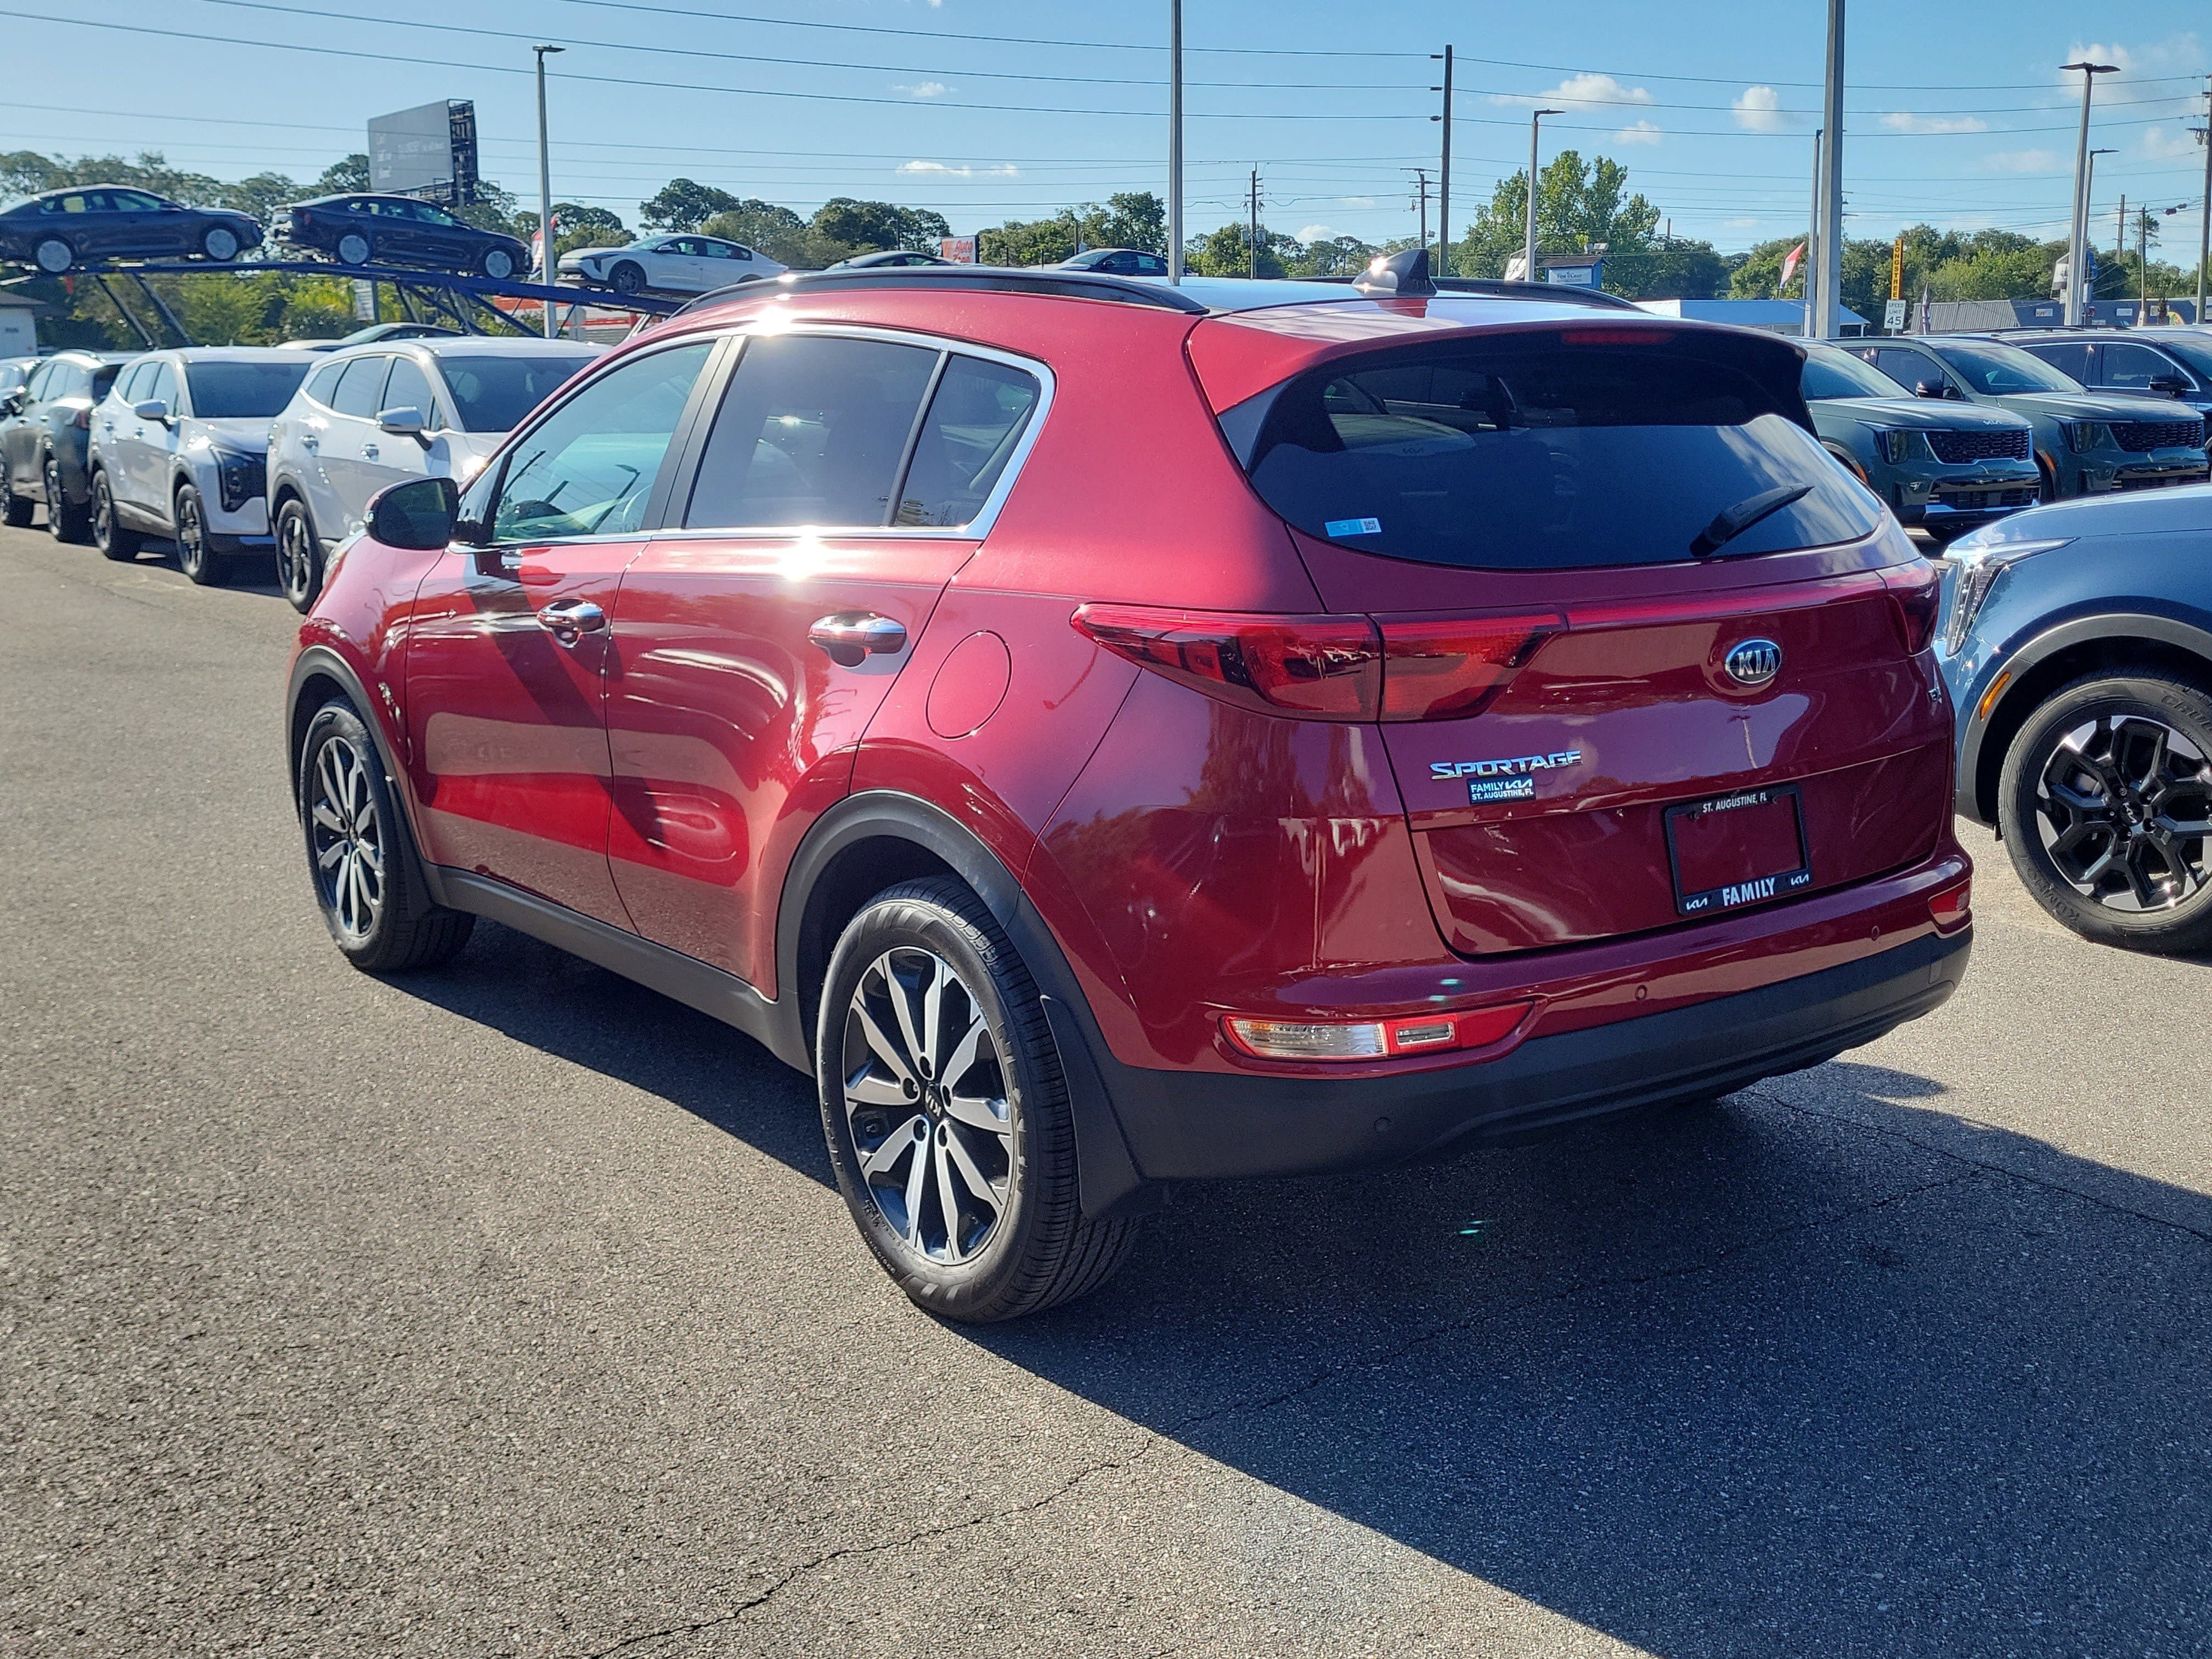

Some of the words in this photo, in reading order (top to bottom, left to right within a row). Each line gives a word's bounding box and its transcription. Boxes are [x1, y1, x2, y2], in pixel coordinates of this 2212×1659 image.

[1887, 316, 1901, 325] 45
[1737, 648, 1776, 676] KIA
[1430, 750, 1583, 780] SPORTAGE
[1470, 781, 1504, 793] FAMILY
[1702, 802, 1713, 813] ST.
[1759, 792, 1767, 802] FL
[1722, 877, 1775, 907] FAMILY
[925, 1090, 942, 1118] KIA
